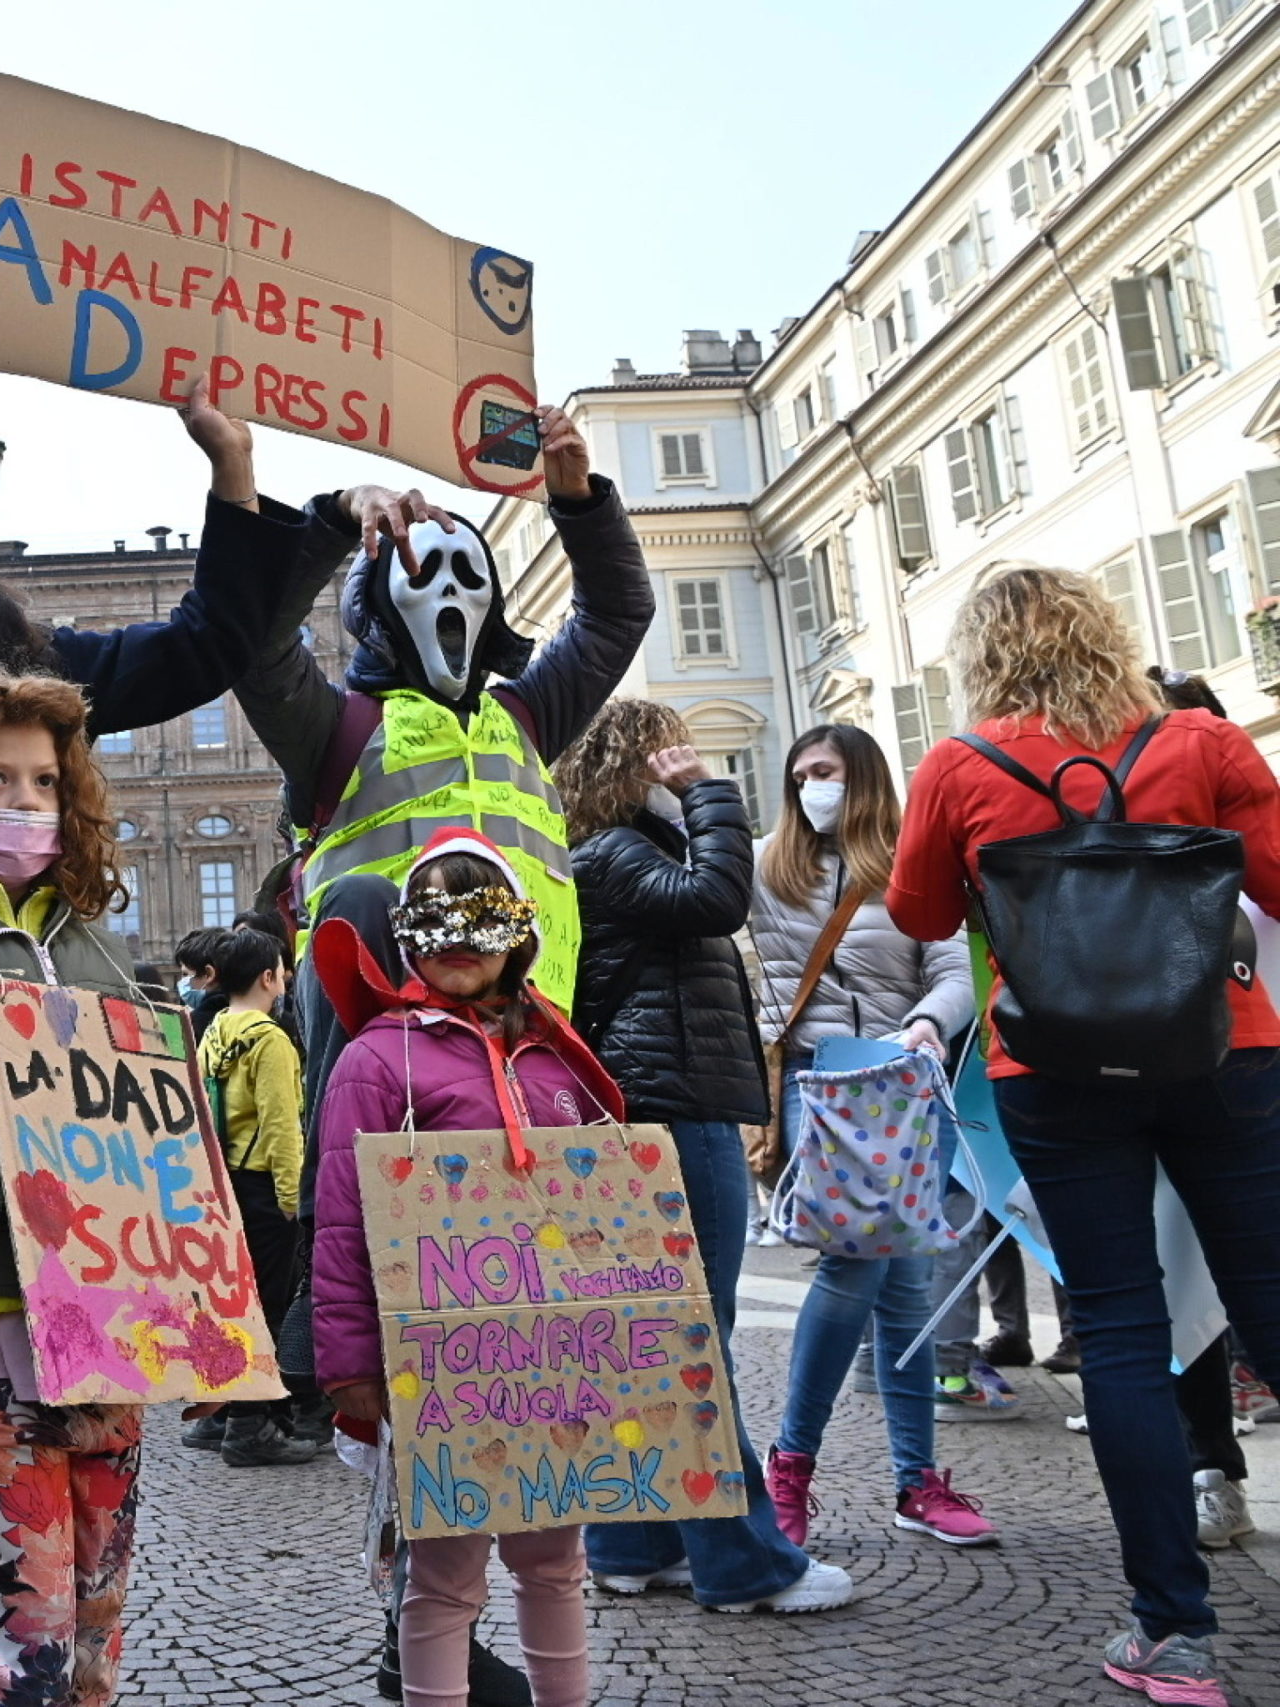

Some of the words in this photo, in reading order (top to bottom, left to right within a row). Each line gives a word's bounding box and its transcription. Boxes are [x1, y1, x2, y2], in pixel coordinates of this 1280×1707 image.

[69, 1048, 195, 1137] DAD
[14, 1113, 145, 1192] NON
[400, 1309, 681, 1383] TORNARE
[416, 1385, 455, 1437] A
[453, 1375, 612, 1428] SCUOLA
[519, 1447, 671, 1523] MASK
